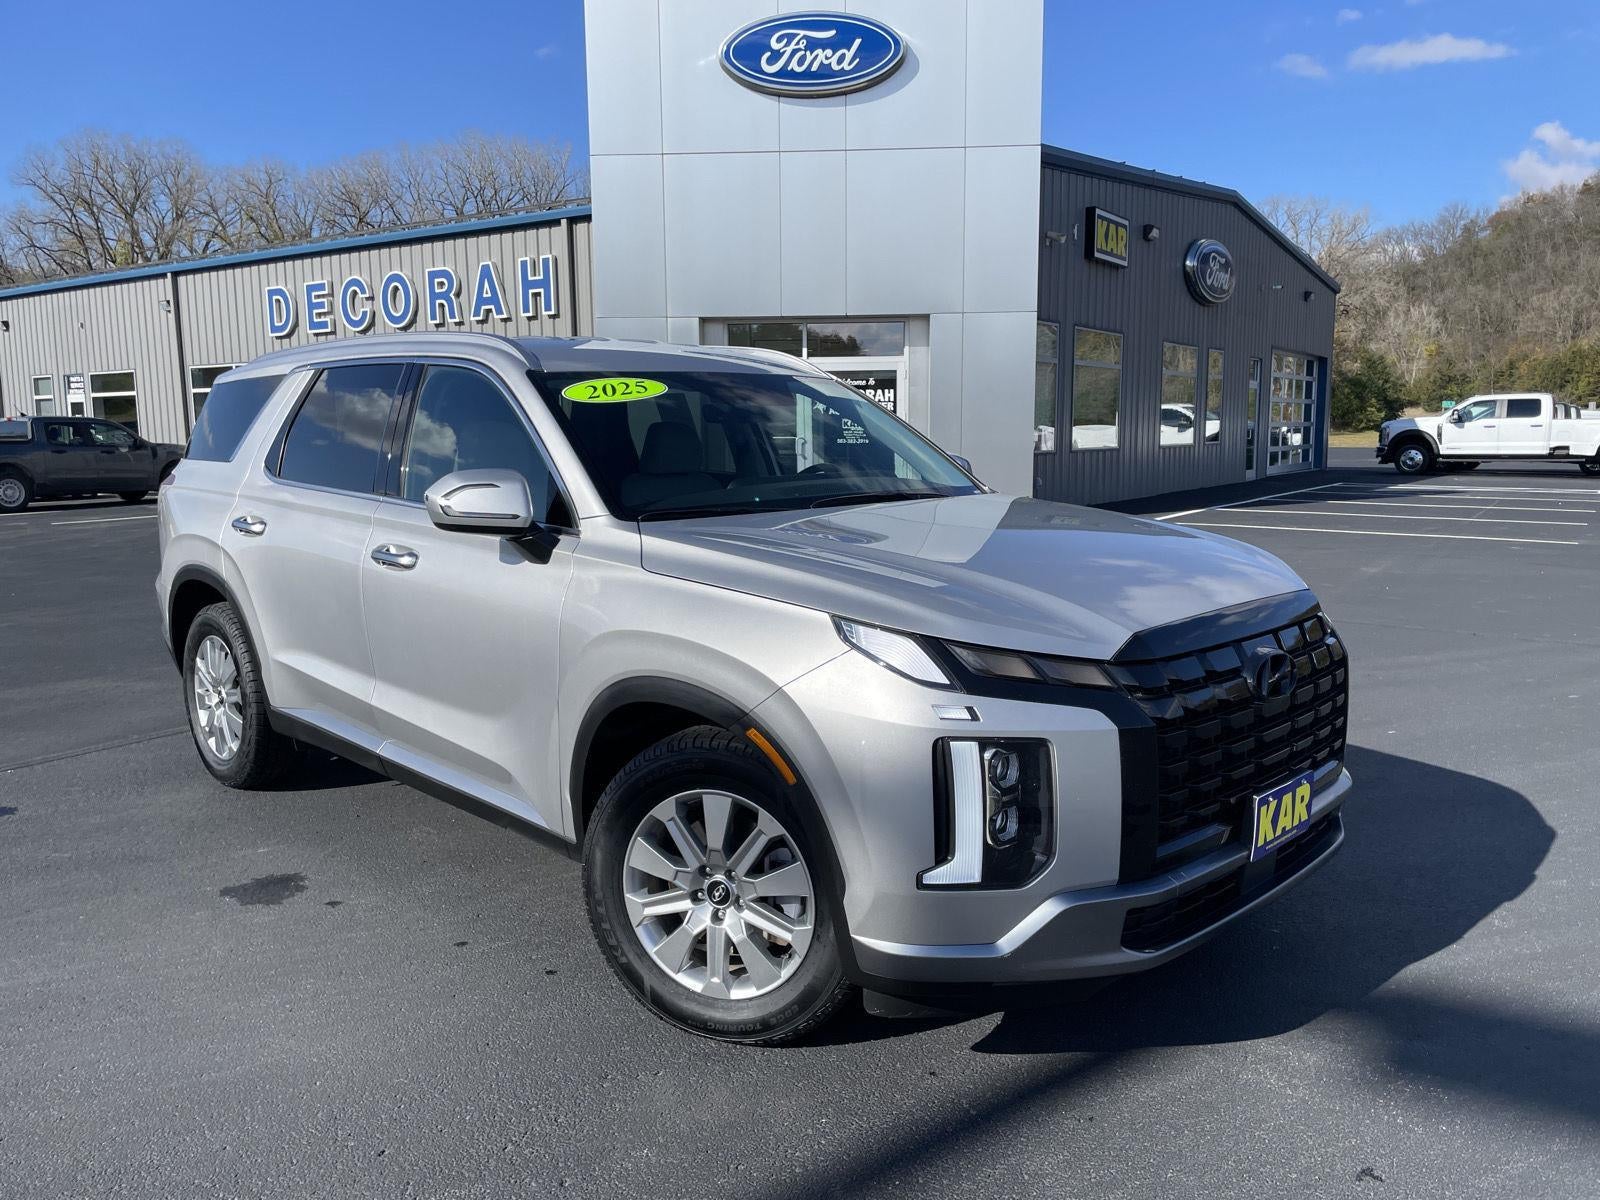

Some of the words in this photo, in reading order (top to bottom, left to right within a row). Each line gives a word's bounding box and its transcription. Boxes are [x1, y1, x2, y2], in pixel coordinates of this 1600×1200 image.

[760, 28, 862, 74] Ford
[1096, 219, 1128, 257] KAR
[1206, 252, 1232, 291] Ford
[265, 254, 559, 338] DECORAH
[584, 380, 648, 400] 2025
[1257, 783, 1311, 847] KAR
